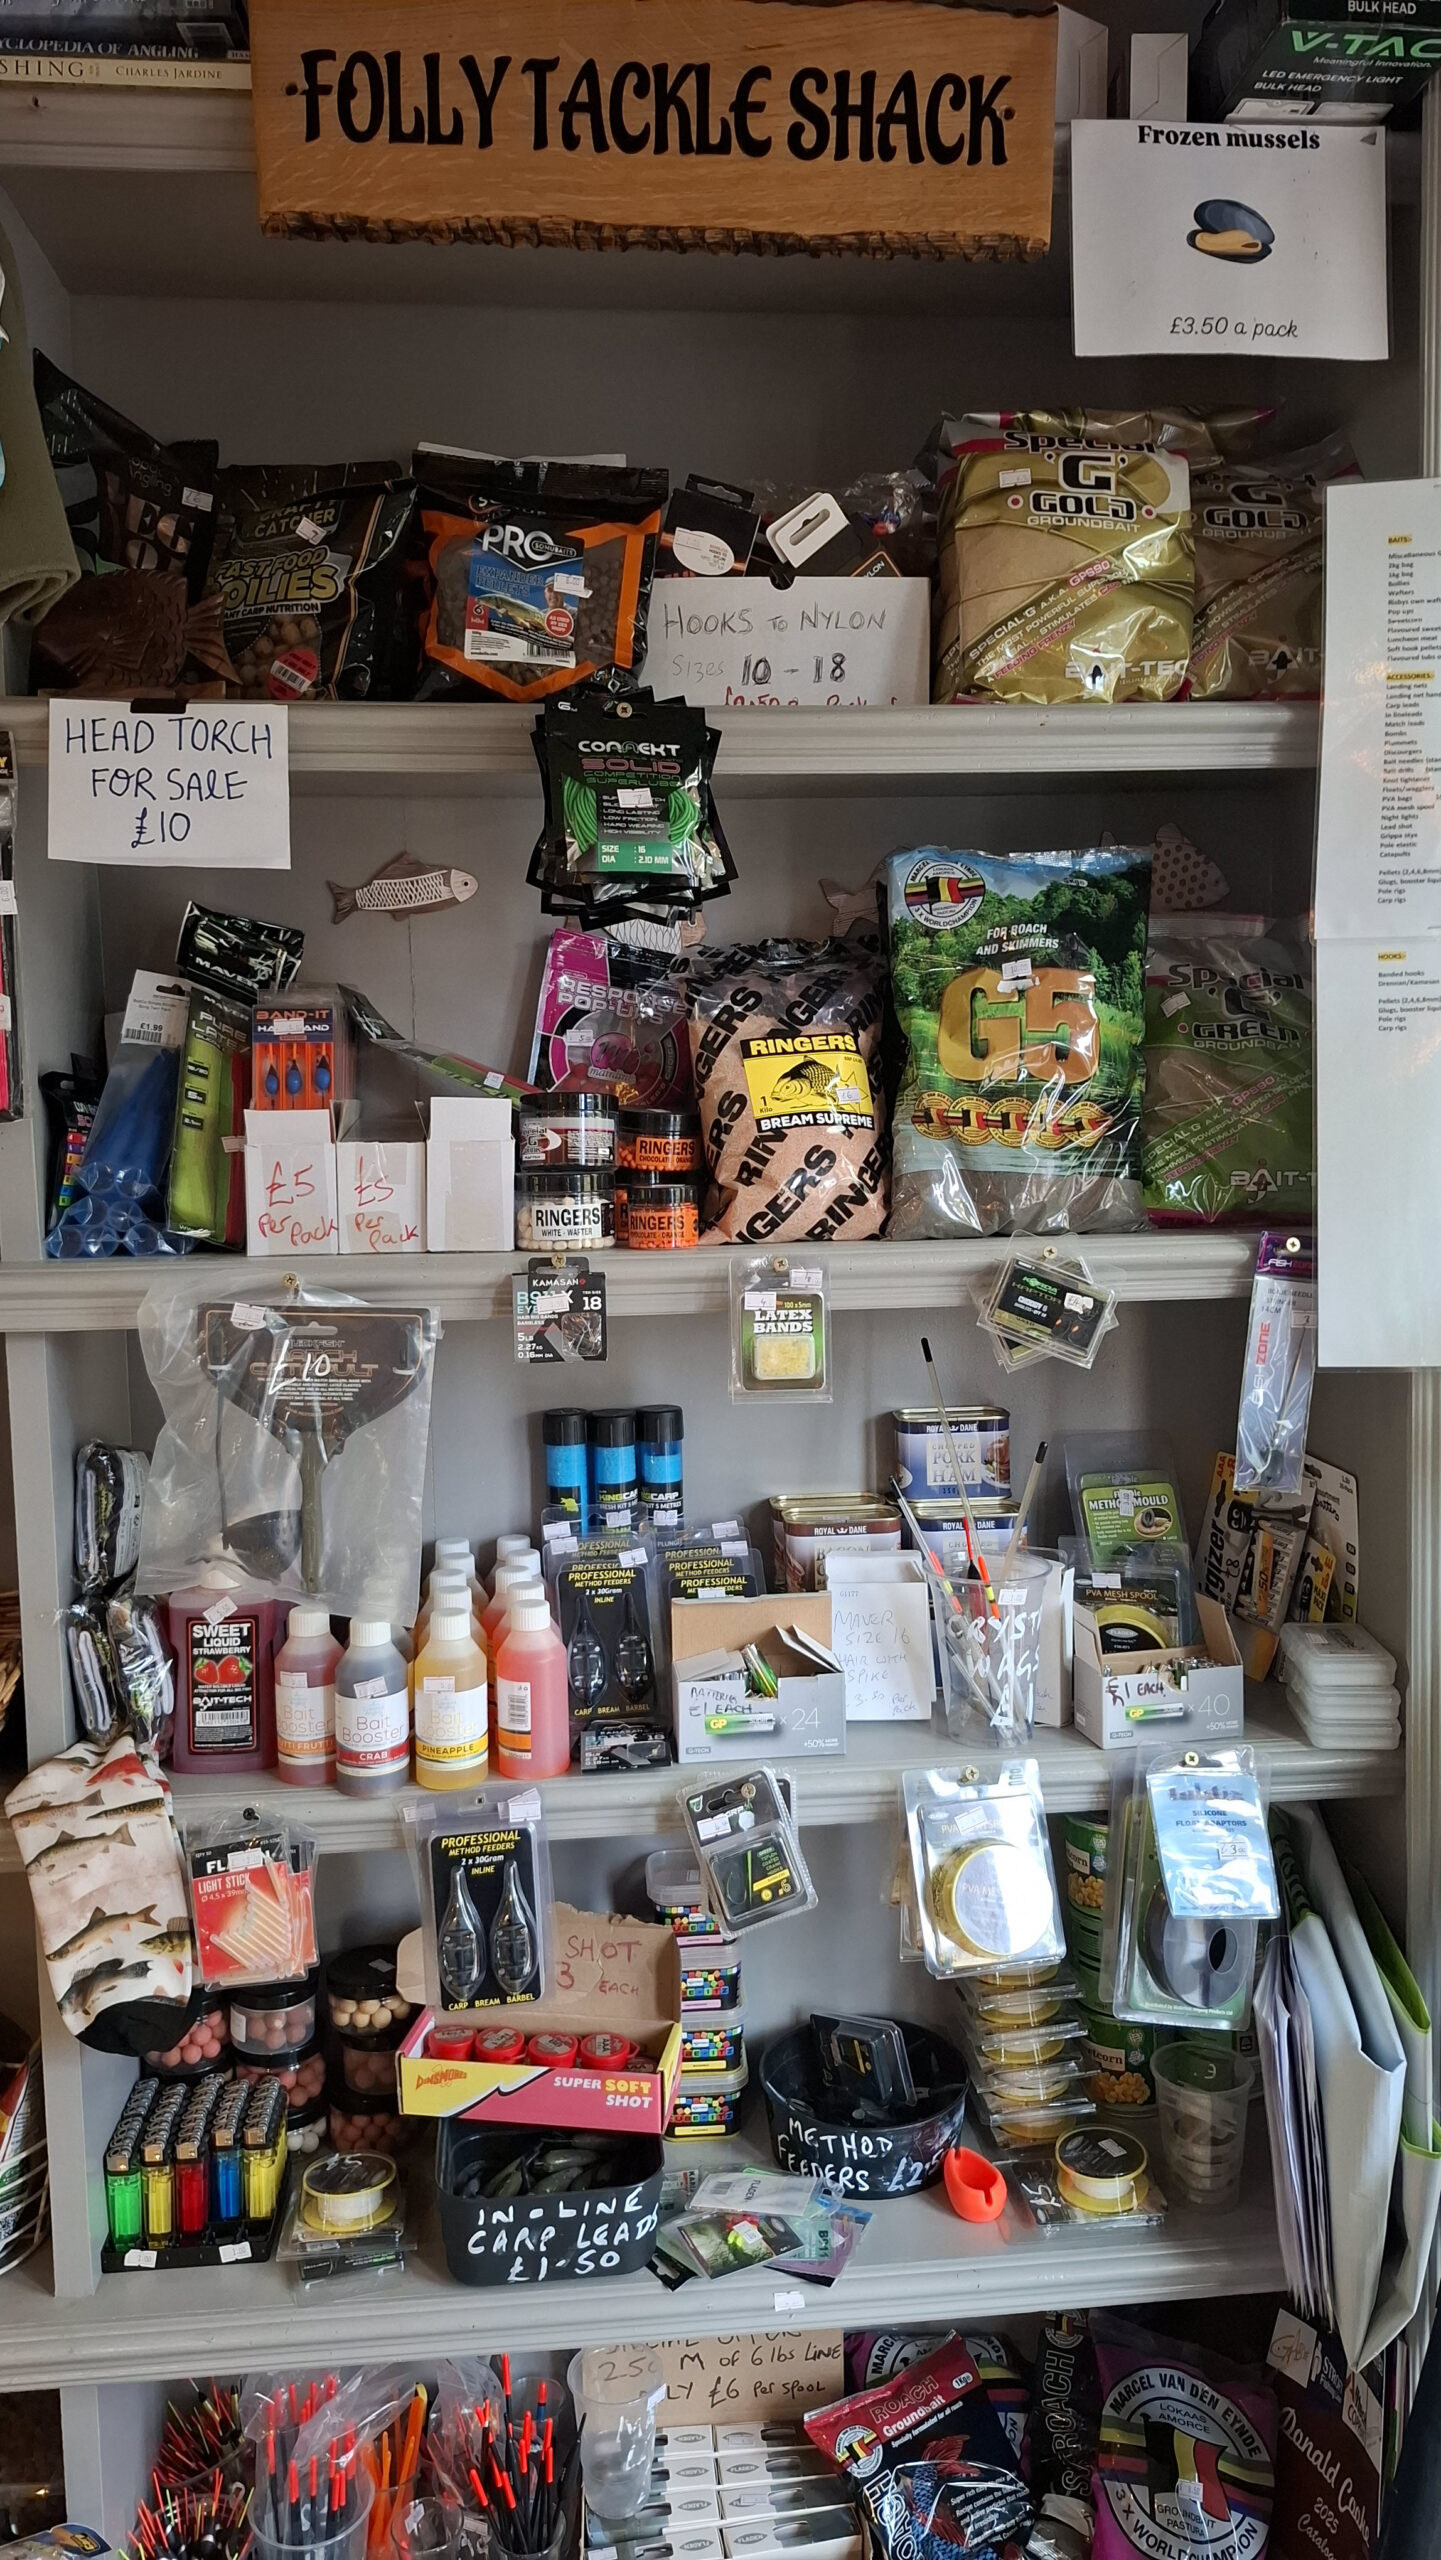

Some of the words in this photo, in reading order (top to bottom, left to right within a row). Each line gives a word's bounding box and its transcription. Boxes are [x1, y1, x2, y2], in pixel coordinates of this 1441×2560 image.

[1347, 1, 1381, 14] BULK
[1382, 2, 1417, 15] HEAD
[97, 43, 122, 55] OF
[127, 44, 199, 59] ANGLING
[1312, 56, 1373, 68] Meaningful
[115, 66, 170, 79] CHARLES
[174, 67, 223, 80] JARDINE
[1261, 69, 1286, 79] LED
[1287, 71, 1364, 84] EMERGENCY
[1365, 75, 1404, 85] LIGHT
[1254, 81, 1286, 91] BULK
[1288, 83, 1322, 93] HEAD
[301, 48, 512, 151] FOLLY
[520, 55, 773, 158] TACKLE
[786, 67, 1012, 167] SHACK
[1138, 124, 1221, 149] Frozen
[1226, 129, 1321, 151] mussels
[1169, 315, 1227, 338] £3.50
[1234, 319, 1248, 336] a
[1252, 318, 1299, 340] pack
[1031, 491, 1136, 522] GOLD
[1026, 515, 1141, 533] GROUNDBAIT
[481, 524, 555, 562] PRO
[272, 548, 324, 572] FOOD
[264, 602, 320, 615] NUTRITION
[664, 604, 753, 640] HOOKS
[799, 602, 887, 631] NYLON
[741, 654, 772, 686] 10
[812, 652, 847, 684] 18
[66, 718, 154, 754] HEAD
[168, 716, 272, 759] TORCH
[581, 758, 681, 774] SOLID
[583, 770, 682, 781] COMPETITION
[92, 768, 156, 801] FOR
[131, 807, 191, 848] £10
[601, 845, 619, 854] SIZE
[601, 855, 616, 864] DIA
[654, 856, 669, 865] MM
[987, 927, 1007, 941] FOR
[1010, 924, 1048, 937] ROACH
[975, 942, 1001, 956] AND
[1001, 938, 1060, 952] SKIMMERS
[256, 1008, 330, 1020] BAND-IT
[139, 1022, 164, 1033] £1.99
[199, 1011, 248, 1043] PURE
[938, 965, 1101, 1085] G5
[749, 1033, 858, 1057] RINGERS
[761, 1115, 814, 1131] BREAM
[816, 1112, 874, 1128] SUPREME
[638, 1138, 696, 1156] RINGERS
[266, 1161, 315, 1208] £5
[353, 1156, 394, 1207] £5
[535, 1206, 601, 1228] RINGERS
[629, 1214, 685, 1231] RINGERS
[541, 1226, 561, 1237] WHITE
[566, 1226, 593, 1236] WAFTER
[532, 1278, 579, 1287] KAMASAN
[582, 1295, 602, 1311] 18
[753, 1309, 814, 1321] LATEX
[753, 1322, 814, 1334] BANDS
[268, 1340, 332, 1395] £10
[959, 1423, 978, 1432] DANE
[933, 1452, 975, 1464] PORK
[933, 1469, 976, 1482] HAM
[1134, 1494, 1169, 1508] MOULD
[814, 1527, 836, 1536] ROYAL
[849, 1525, 868, 1534] DANE
[568, 1569, 637, 1581] PROFESSIONAL
[574, 1580, 600, 1588] METHOD
[600, 1578, 632, 1586] FEEDERS
[680, 1576, 748, 1587] PROFESSIONAL
[1085, 1588, 1102, 1597] PVA
[1102, 1589, 1128, 1598] MESH
[1129, 1590, 1157, 1600] SPOOL
[834, 1610, 894, 1629] MAVER
[192, 1623, 252, 1638] SWEET
[894, 1629, 911, 1645] 16
[192, 1646, 252, 1656] STRAWBERRY
[203, 1637, 241, 1648] LIQUID
[1136, 1682, 1165, 1696] EACH
[1128, 1709, 1144, 1718] GP
[1197, 1692, 1231, 1717] 40
[357, 1715, 391, 1730] Bait
[709, 1718, 728, 1730] GP
[791, 1707, 821, 1731] 24
[342, 1726, 405, 1745] Booster
[359, 1751, 389, 1761] CRAB
[422, 1743, 475, 1755] PINEAPPLE
[1192, 1809, 1228, 1817] SILICONE
[441, 1830, 522, 1849] PROFESSIONAL
[448, 1844, 481, 1857] METHOD
[482, 1841, 515, 1853] FEEDERS
[474, 1853, 504, 1864] 30Gram
[471, 1865, 496, 1876] INLINE
[198, 1878, 223, 1895] LIGHT
[225, 1871, 251, 1890] STICK
[564, 1935, 642, 1963] SHOT
[598, 1979, 640, 1996] EACH
[448, 2001, 469, 2011] CARP
[474, 1997, 501, 2008] BREAM
[506, 1993, 536, 2004] BARBEL
[553, 2076, 602, 2090] SUPER
[604, 2079, 652, 2095] SOFT
[605, 2094, 653, 2109] SHOT
[787, 2117, 893, 2160] METHOD
[467, 2226, 556, 2255] CARP
[576, 2201, 660, 2249] LEADS
[751, 2348, 764, 2366] 6
[708, 2375, 740, 2409] £6
[868, 2375, 940, 2425] ROACH
[881, 2395, 947, 2439] Groundbait
[1108, 2372, 1156, 2416] MARCEL
[1158, 2371, 1188, 2393] VAN
[1188, 2383, 1220, 2411] DEN
[1221, 2405, 1263, 2460] EYNDE
[1159, 2402, 1208, 2423] LOKAAS
[1157, 2412, 1211, 2435] AMORCE
[1280, 2405, 1341, 2489] Donald
[1313, 2496, 1340, 2535] 2025
[1166, 2517, 1205, 2537] PASTURA
